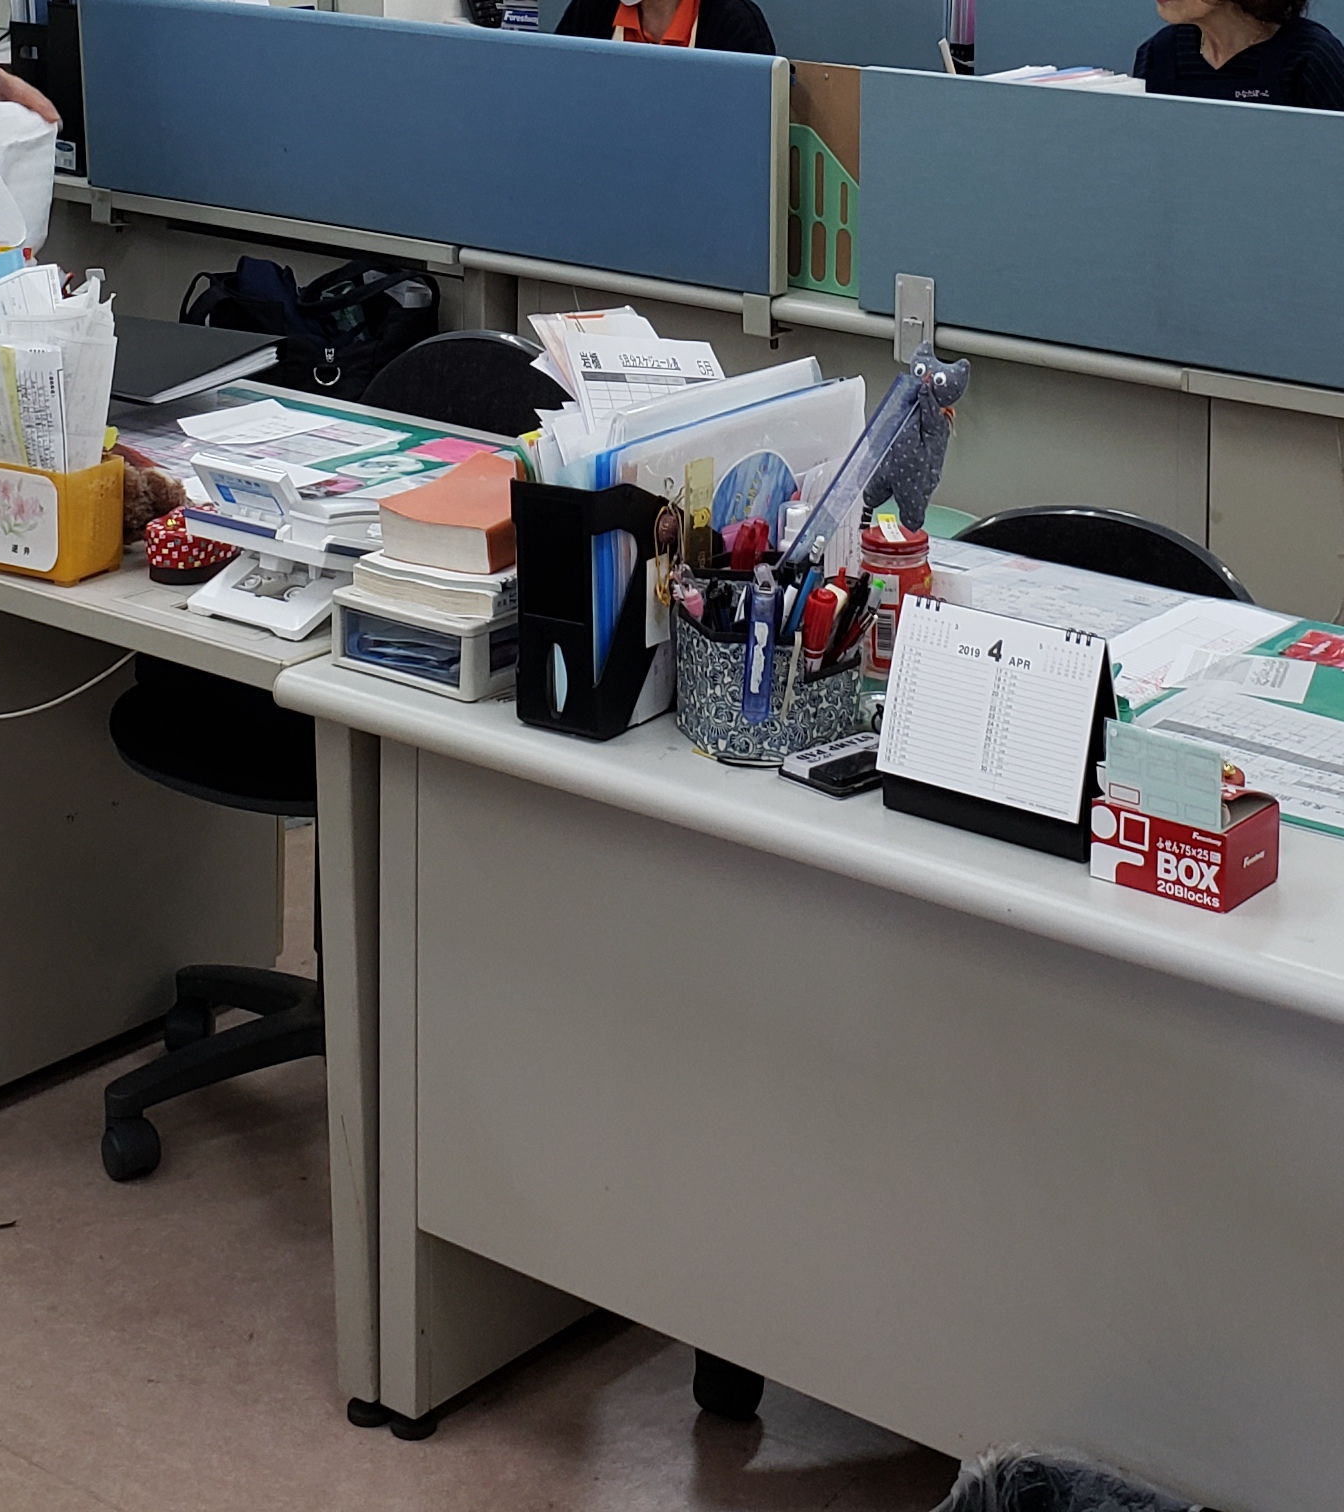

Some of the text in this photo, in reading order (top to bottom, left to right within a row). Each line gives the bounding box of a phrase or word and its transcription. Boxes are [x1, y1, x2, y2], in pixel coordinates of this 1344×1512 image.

[696, 360, 715, 377] 5月
[958, 639, 1032, 671] 2019 4 APR
[795, 748, 828, 761] PAD
[828, 734, 874, 752] STAMP
[1157, 849, 1221, 895] BOX
[1156, 880, 1220, 908] 20Blocks
